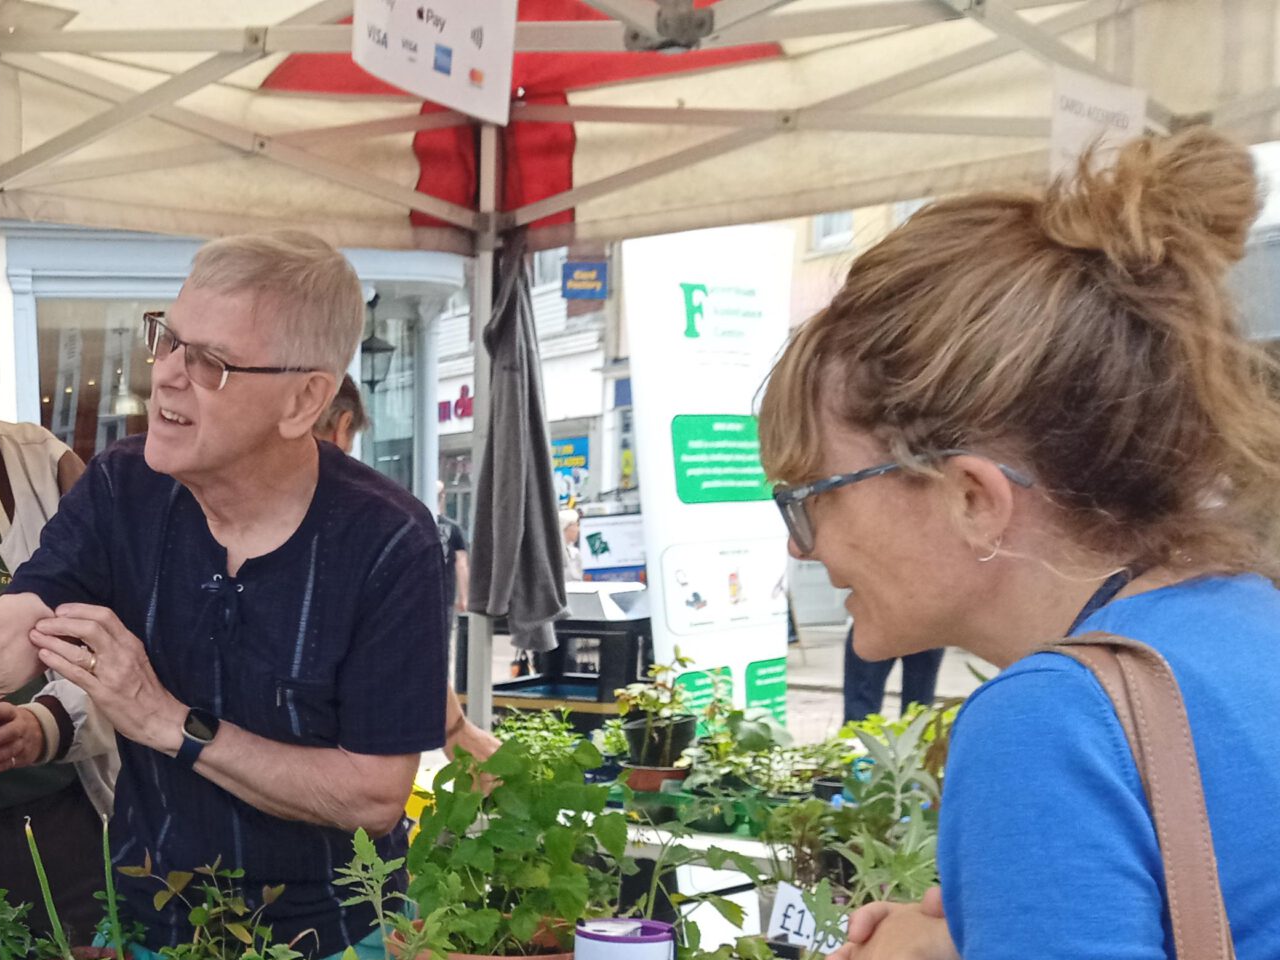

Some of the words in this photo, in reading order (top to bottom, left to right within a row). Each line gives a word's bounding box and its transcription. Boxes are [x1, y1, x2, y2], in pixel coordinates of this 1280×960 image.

[426, 9, 447, 33] Pay
[368, 23, 388, 49] VISA
[401, 38, 418, 53] VISA
